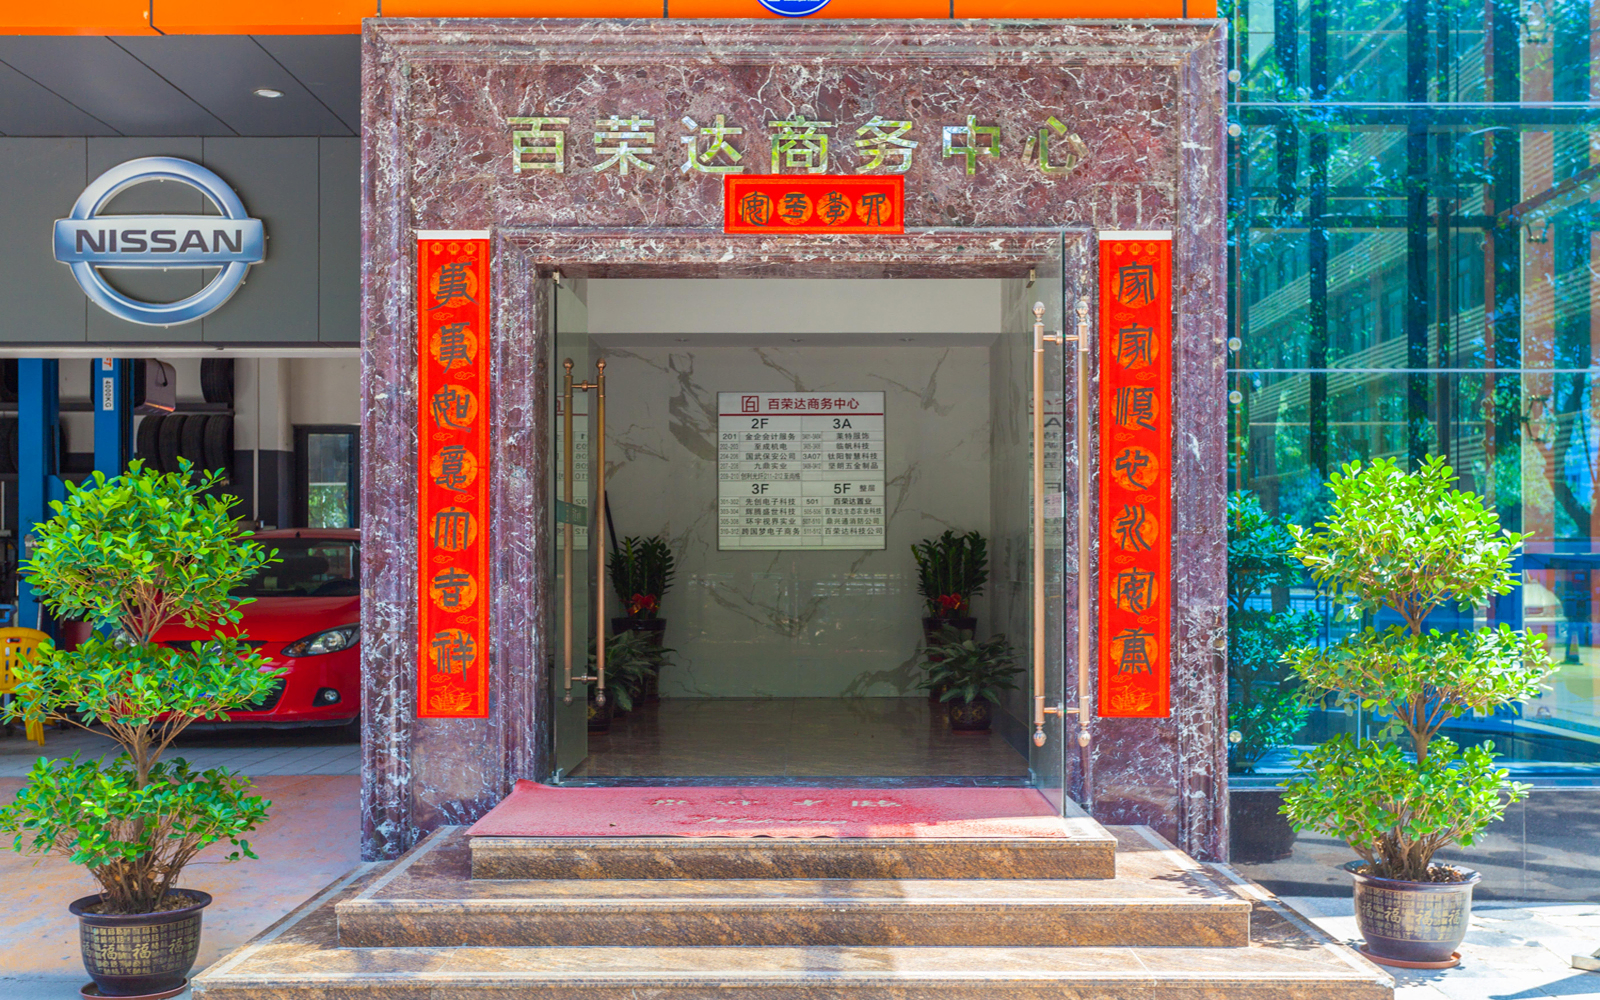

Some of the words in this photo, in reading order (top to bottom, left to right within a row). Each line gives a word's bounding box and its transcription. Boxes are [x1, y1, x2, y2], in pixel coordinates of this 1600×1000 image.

[506, 113, 1088, 176] 百荣达商务中心
[76, 229, 243, 254] NISSAN
[768, 398, 860, 410] 百荣达商务中心
[751, 418, 769, 429] 2F
[832, 418, 852, 429] 3A
[751, 484, 769, 494] 3F
[834, 483, 851, 494] 5F
